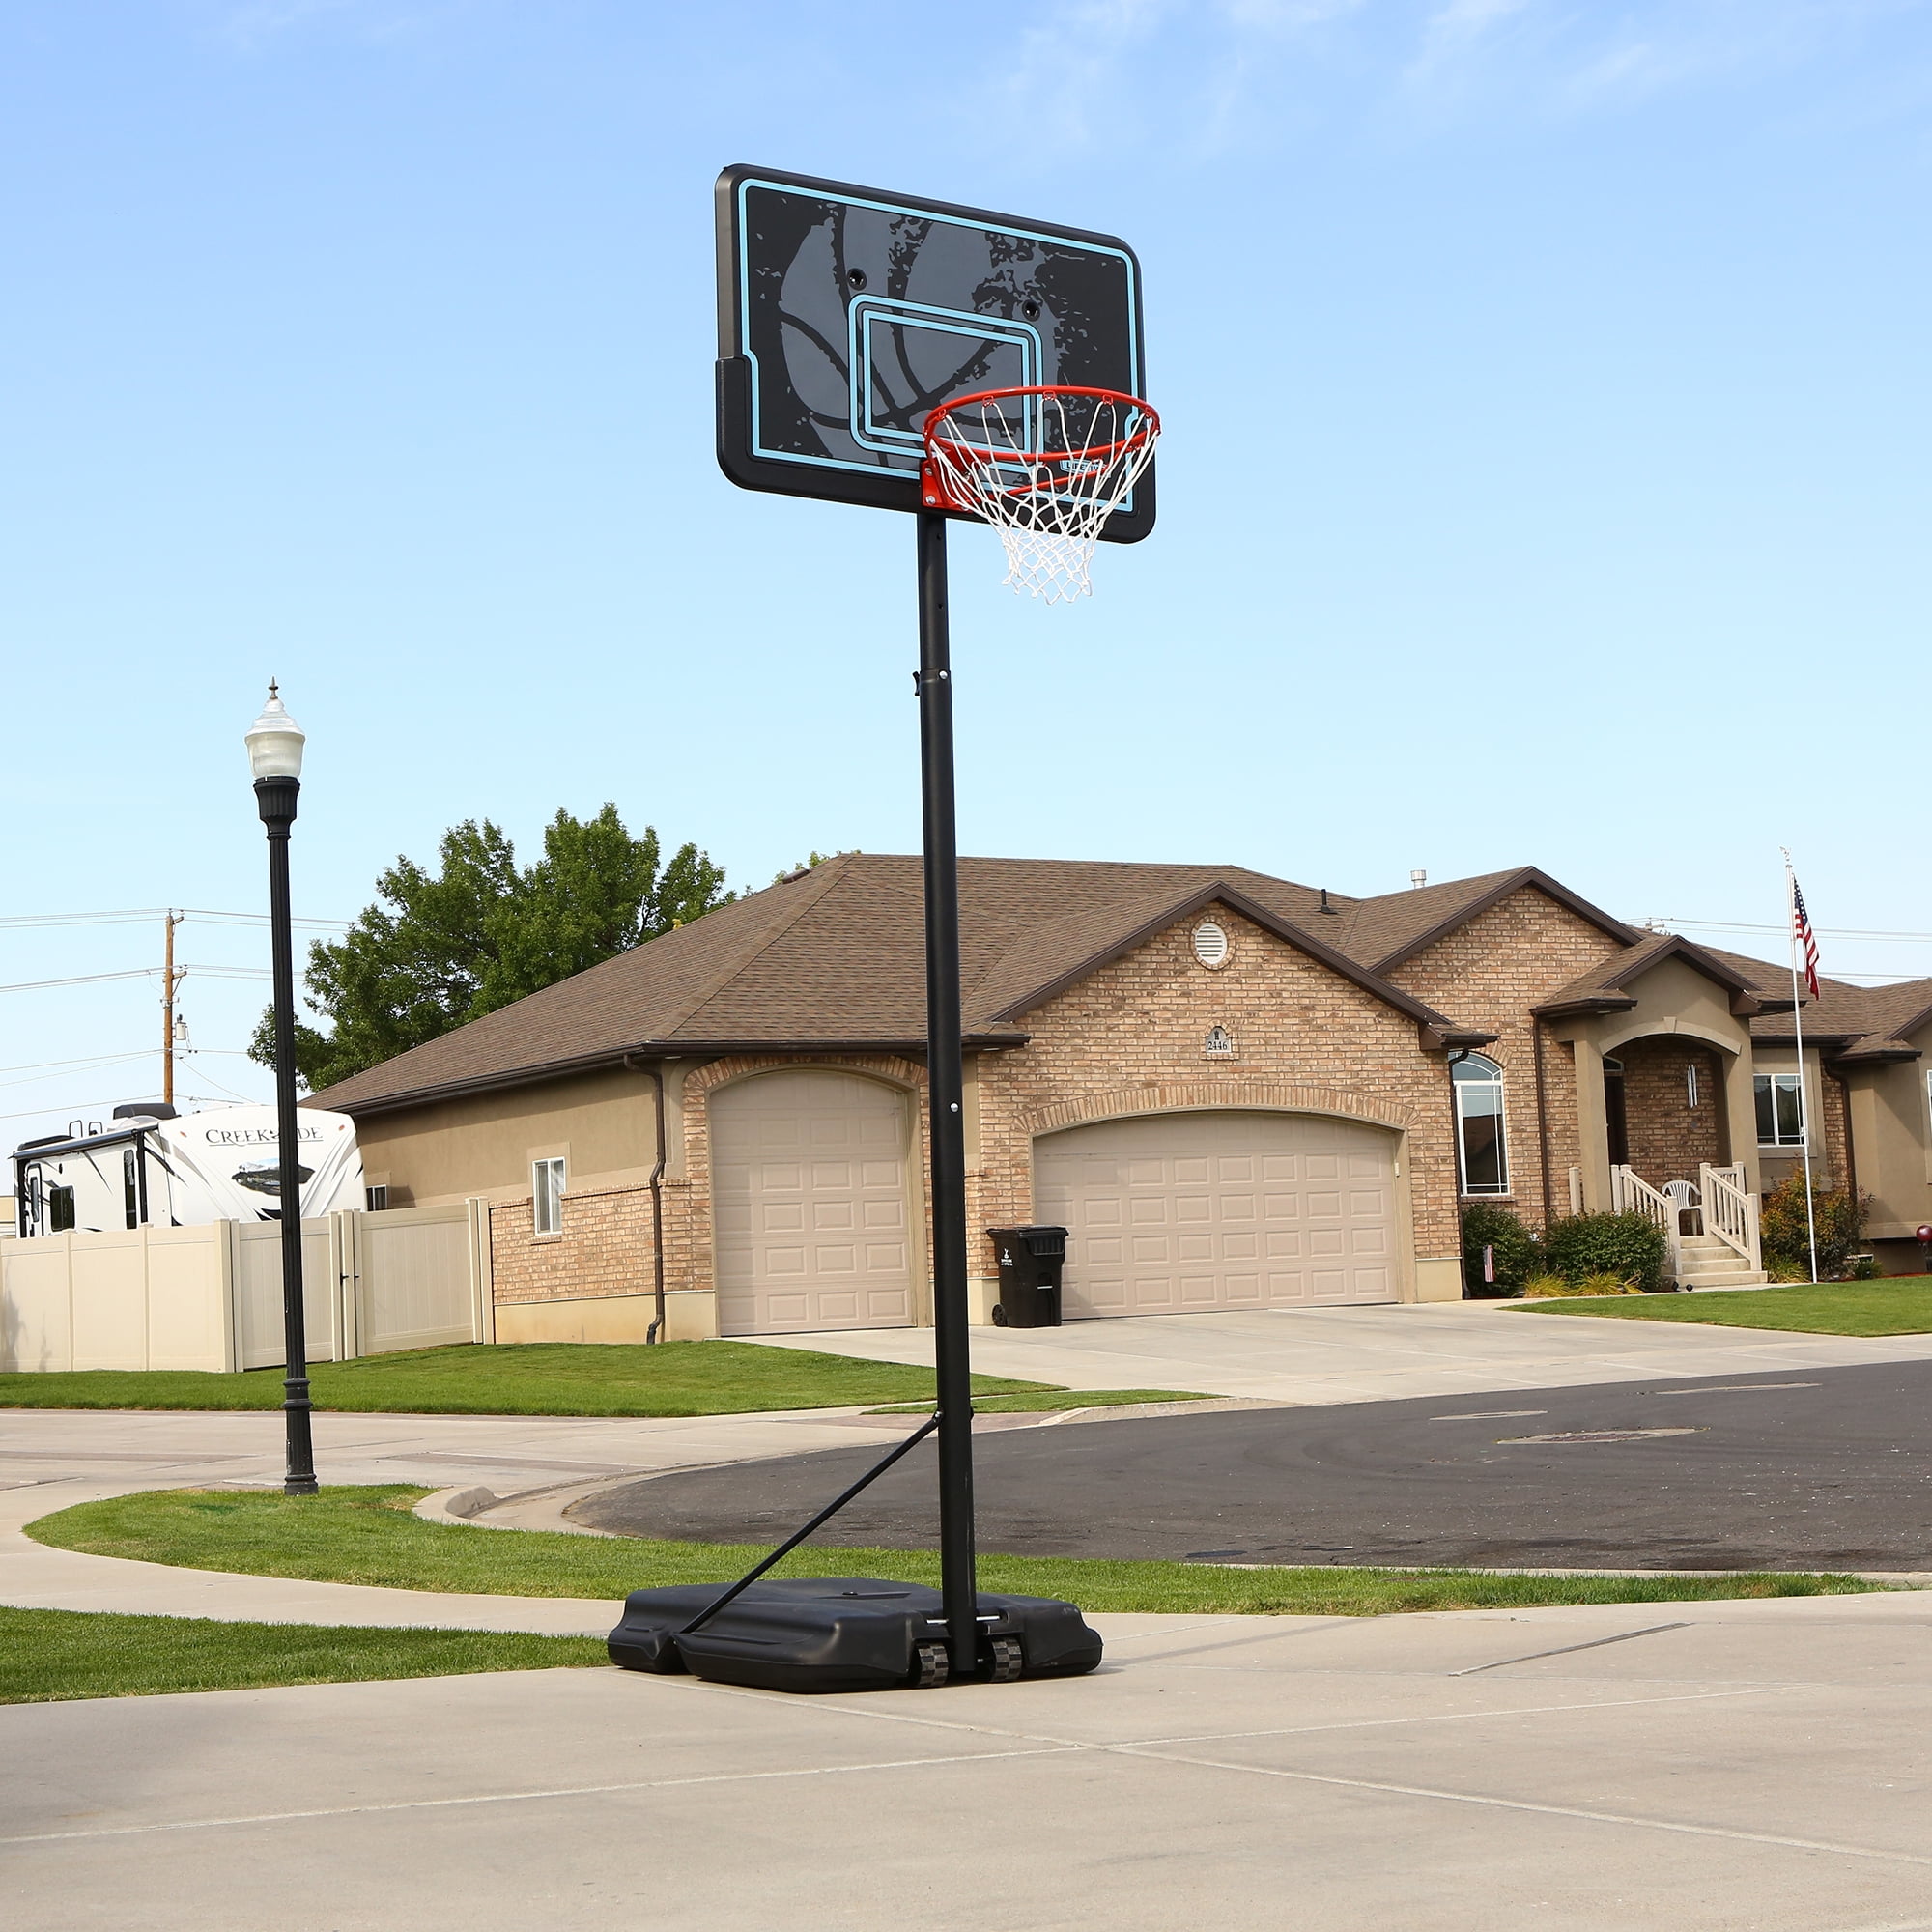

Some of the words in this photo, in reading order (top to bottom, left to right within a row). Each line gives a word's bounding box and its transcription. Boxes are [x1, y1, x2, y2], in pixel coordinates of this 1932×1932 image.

[1066, 461, 1105, 471] LIFEIM
[1208, 1041, 1228, 1051] 2446
[205, 1127, 324, 1146] CREEKDE
